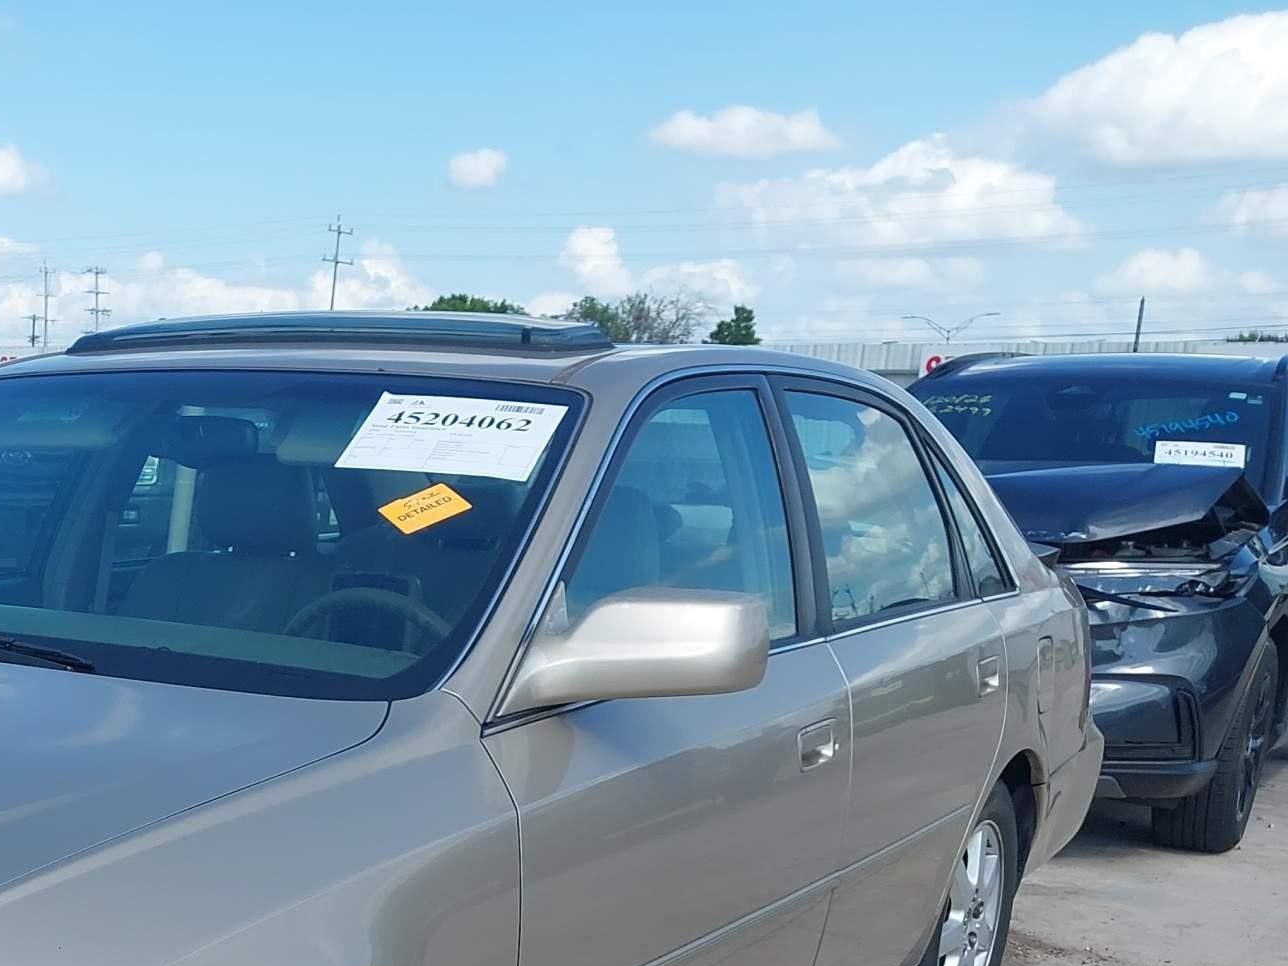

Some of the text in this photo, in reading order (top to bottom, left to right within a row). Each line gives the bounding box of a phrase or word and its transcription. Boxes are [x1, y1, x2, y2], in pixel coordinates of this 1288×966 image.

[386, 409, 532, 431] 45204062
[1134, 410, 1240, 438] 45194540
[1165, 448, 1234, 459] 45194540
[397, 496, 453, 522] DETAILED
